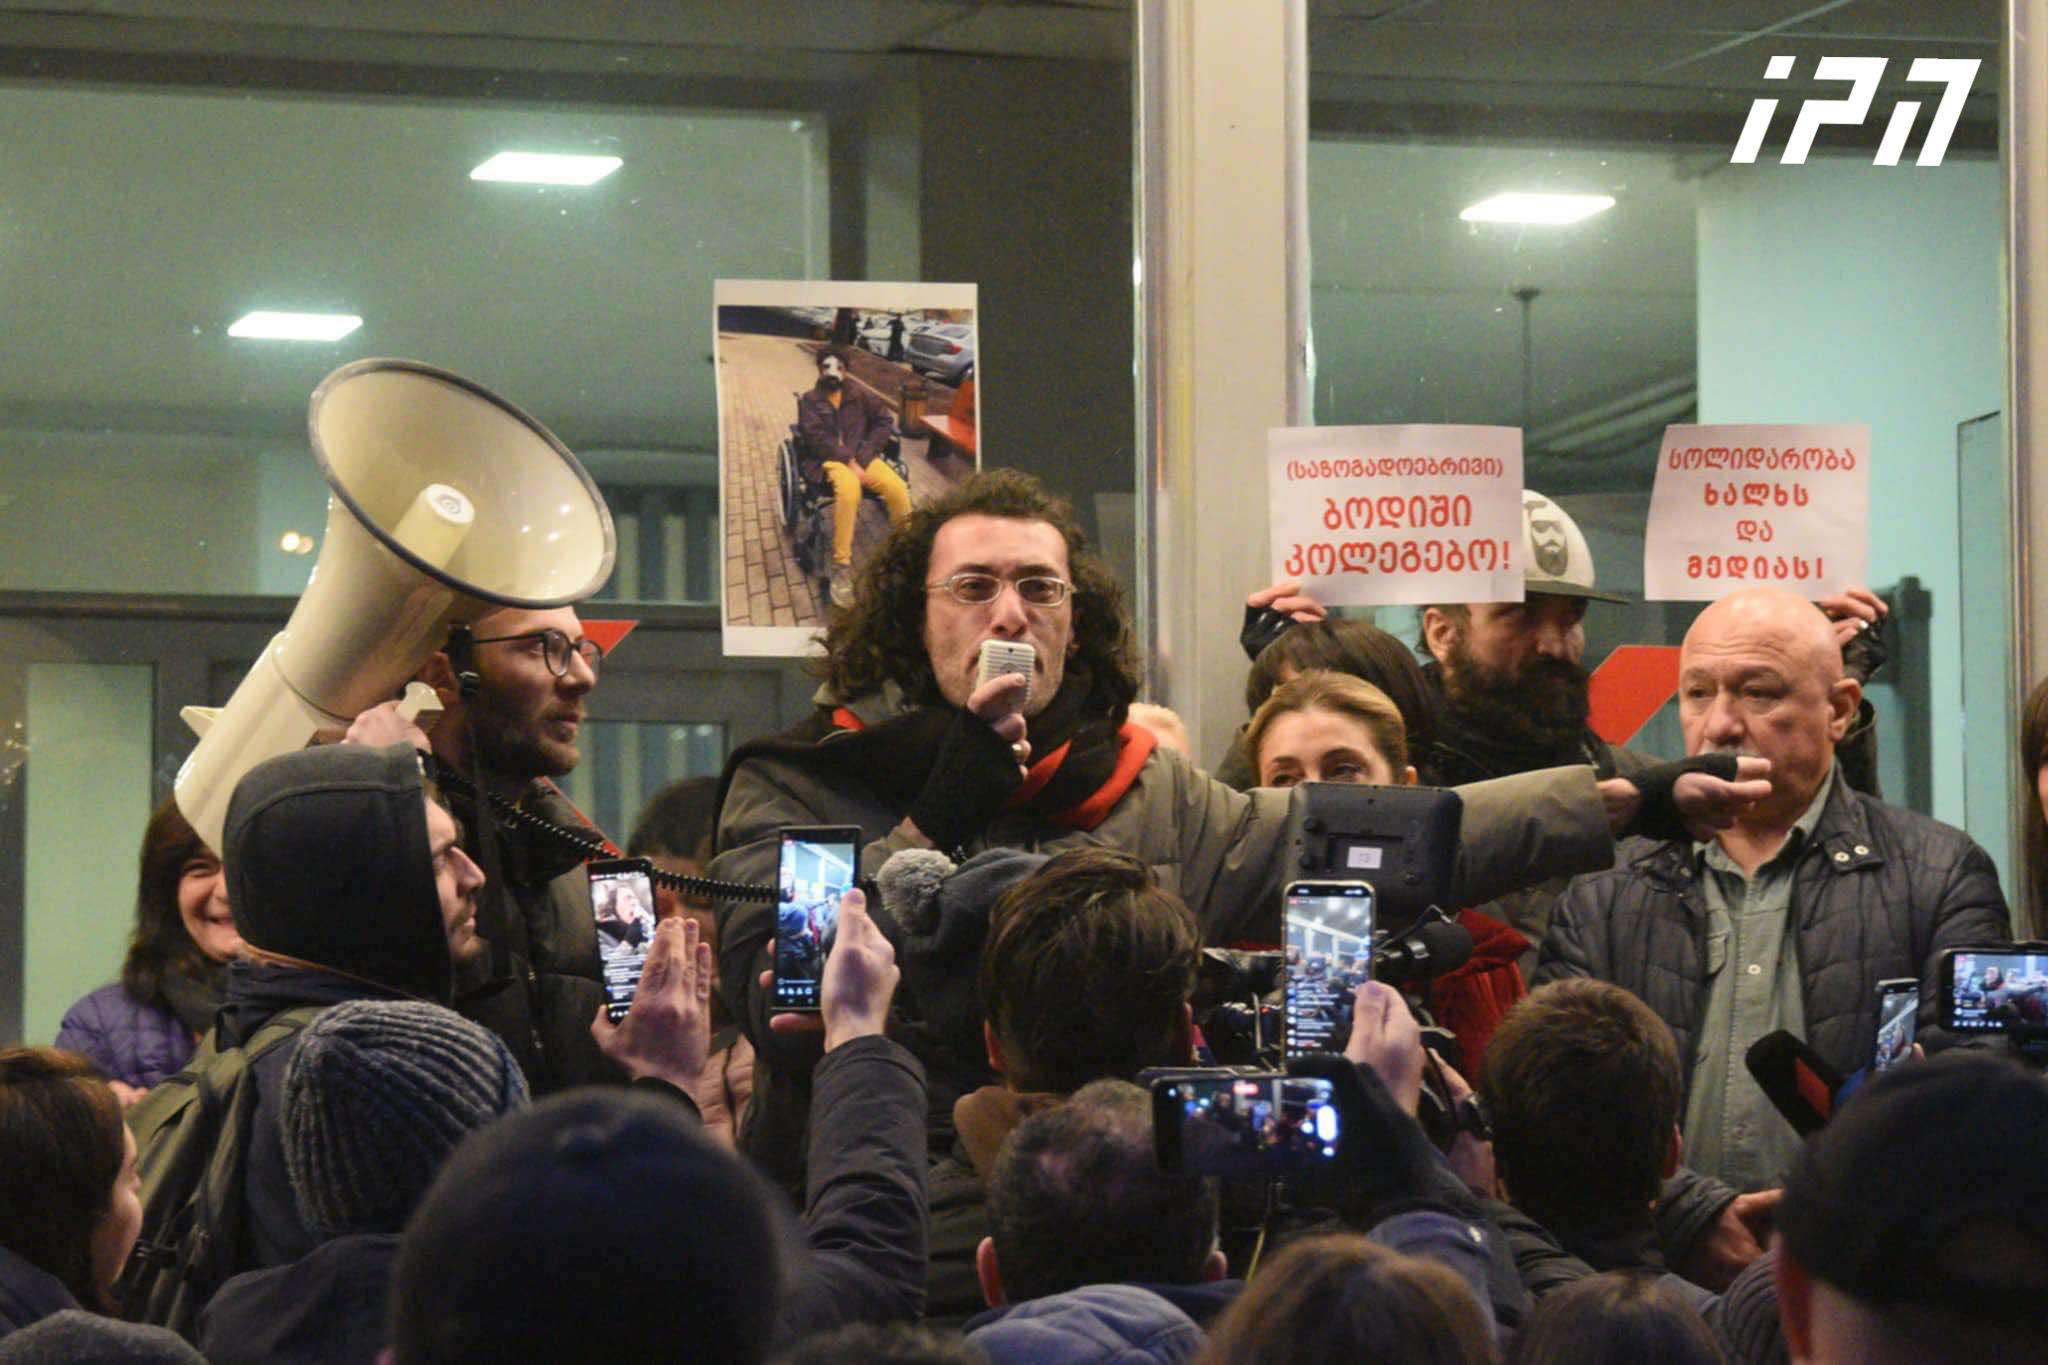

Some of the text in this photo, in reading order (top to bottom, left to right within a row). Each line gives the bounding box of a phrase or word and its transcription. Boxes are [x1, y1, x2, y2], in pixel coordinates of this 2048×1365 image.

[1286, 456, 1505, 480] (საზოგადოებრივი)
[1668, 447, 1857, 473] სოლიდარობა
[1703, 481, 1810, 508] ხალხს
[1322, 495, 1473, 531] ბოდიში
[1734, 519, 1775, 544] და
[1284, 537, 1511, 577] კოლეგებო!
[1686, 553, 1826, 581] მედიას!
